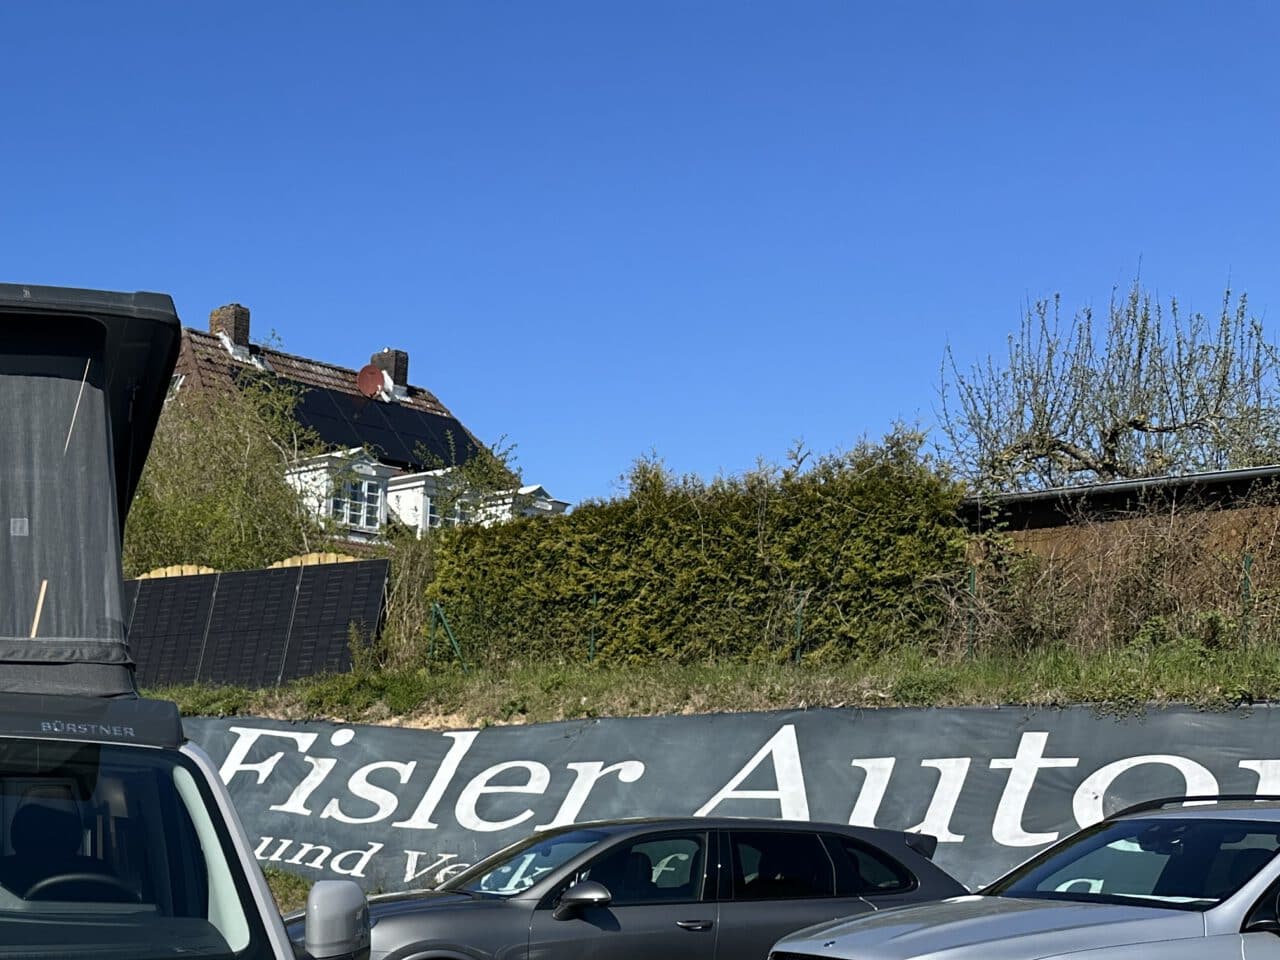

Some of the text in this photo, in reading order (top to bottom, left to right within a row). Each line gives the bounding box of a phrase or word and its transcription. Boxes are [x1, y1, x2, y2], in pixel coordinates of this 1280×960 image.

[41, 720, 136, 737] BÜRSTNER
[692, 724, 1280, 847] Auto
[254, 836, 384, 878] und
